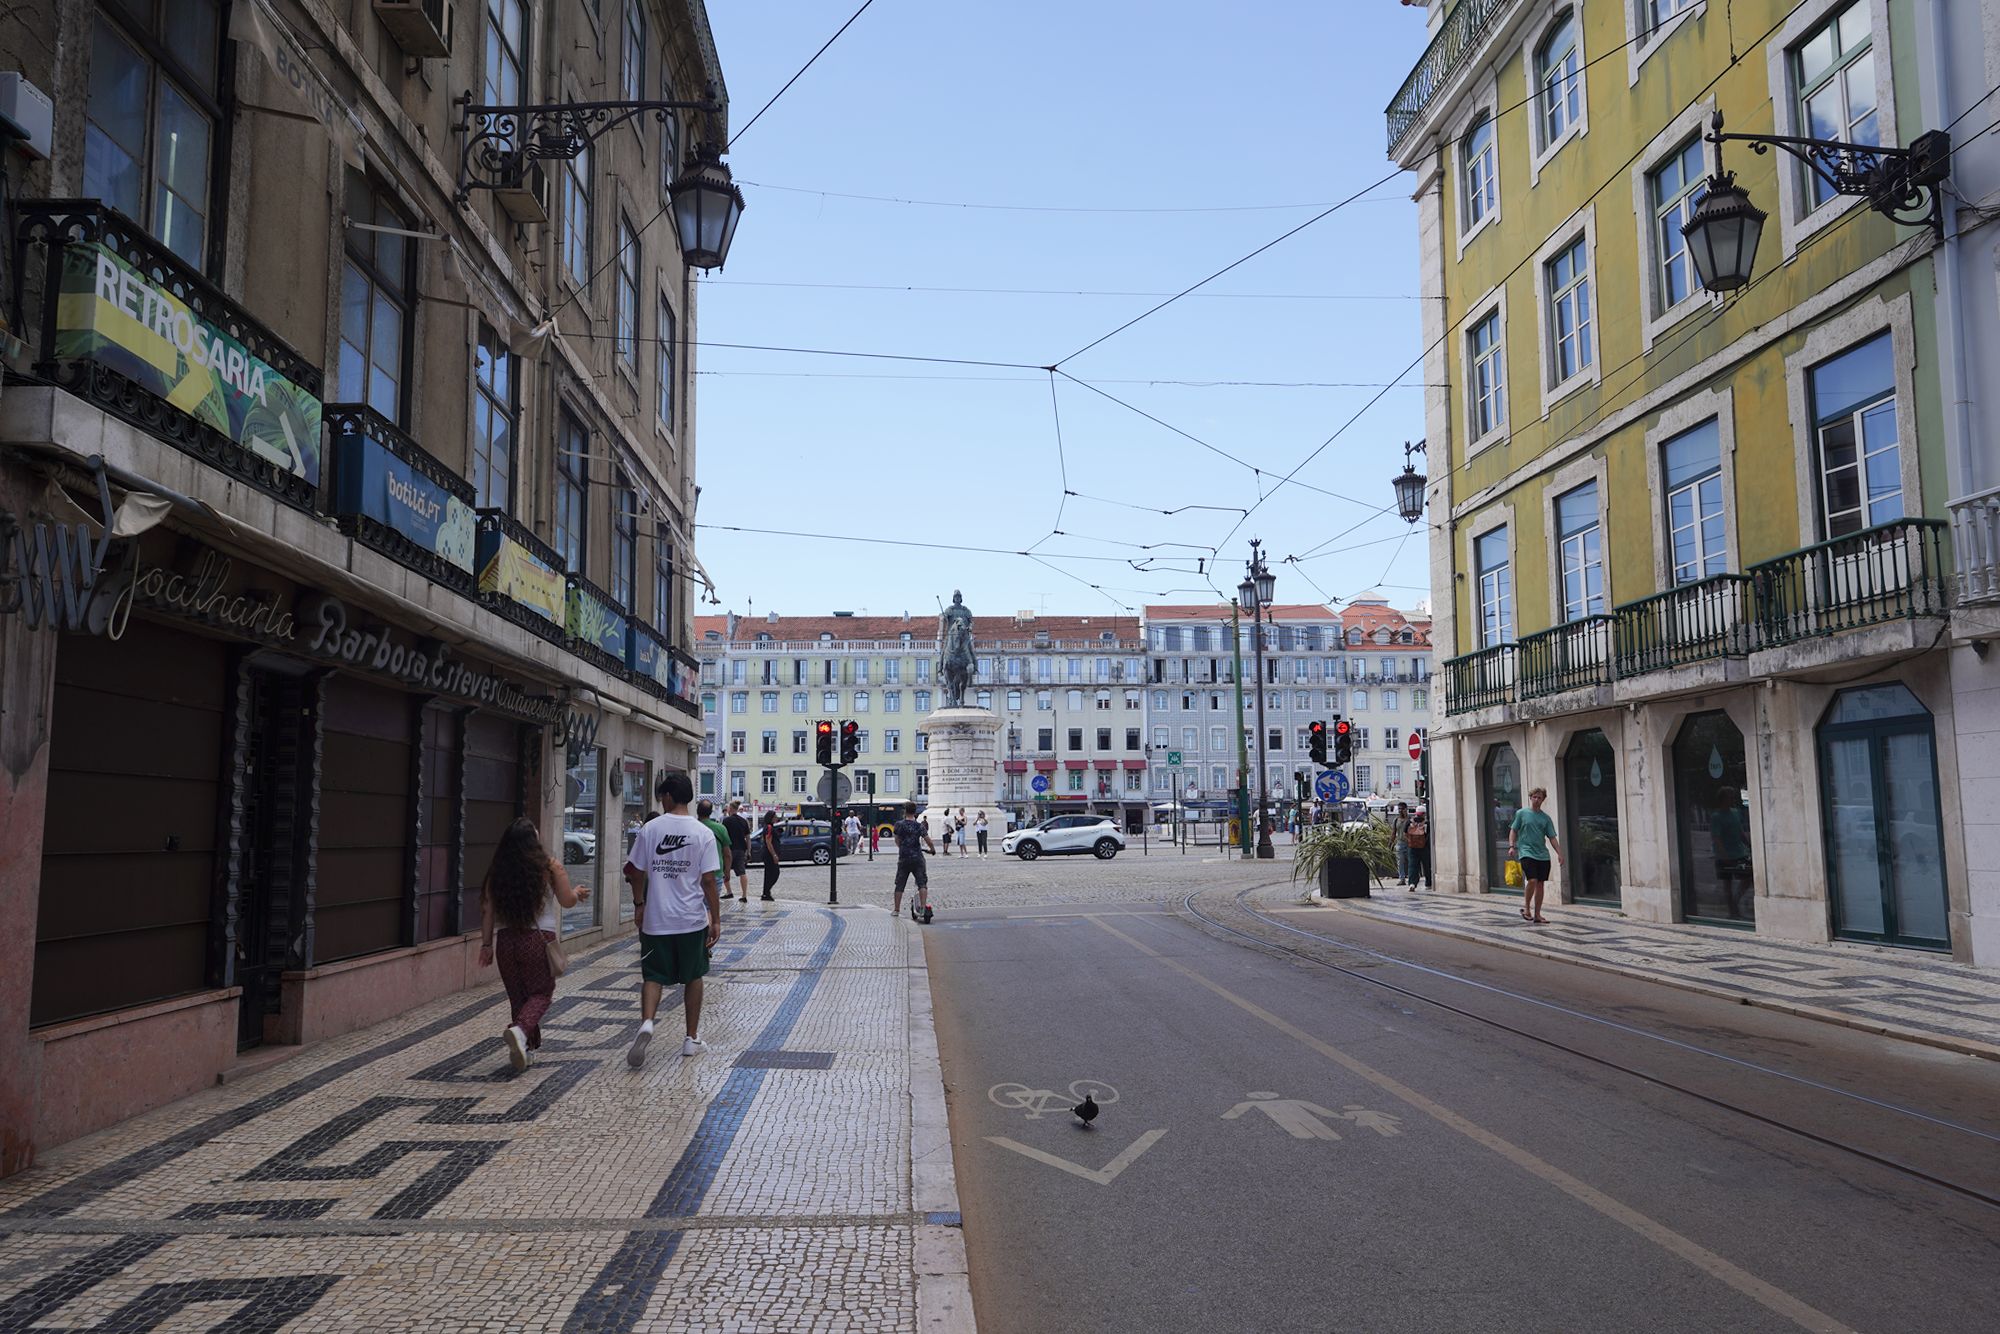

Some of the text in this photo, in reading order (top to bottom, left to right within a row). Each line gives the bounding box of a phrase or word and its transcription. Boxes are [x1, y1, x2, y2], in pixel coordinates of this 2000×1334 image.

[95, 252, 267, 408] RETROSARIA
[431, 642, 498, 702] Esteves
[661, 834, 687, 846] NIKE
[652, 859, 691, 867] AUTHORIZED
